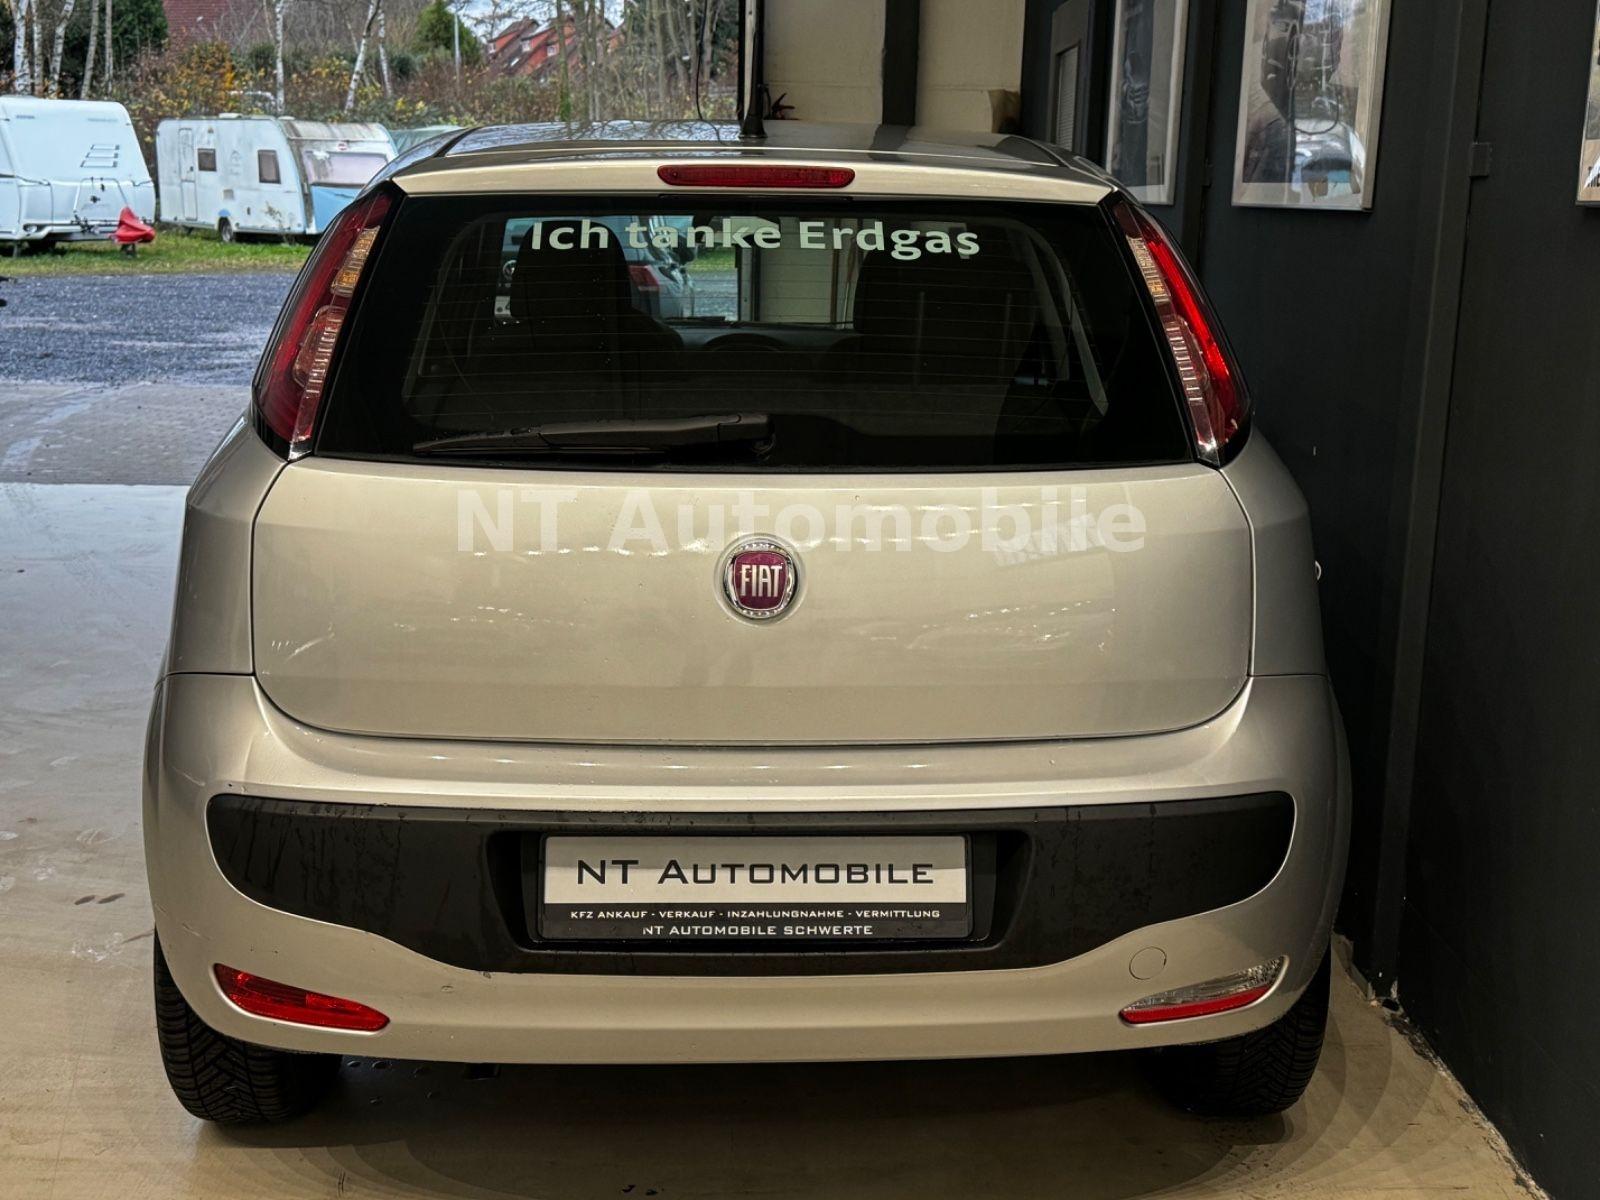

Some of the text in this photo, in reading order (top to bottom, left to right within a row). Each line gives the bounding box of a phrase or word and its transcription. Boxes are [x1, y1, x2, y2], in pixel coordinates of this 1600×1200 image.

[531, 219, 981, 261] Ich tanke Erdgas
[740, 564, 783, 597] FIAT
[577, 859, 639, 884] NT
[570, 911, 594, 919] KFZ
[727, 910, 844, 918] INZAHLUNGNAHME
[855, 910, 940, 918] VERMITTLUNG
[642, 925, 874, 935] NT AUTOMOBILE SCHWERTE
